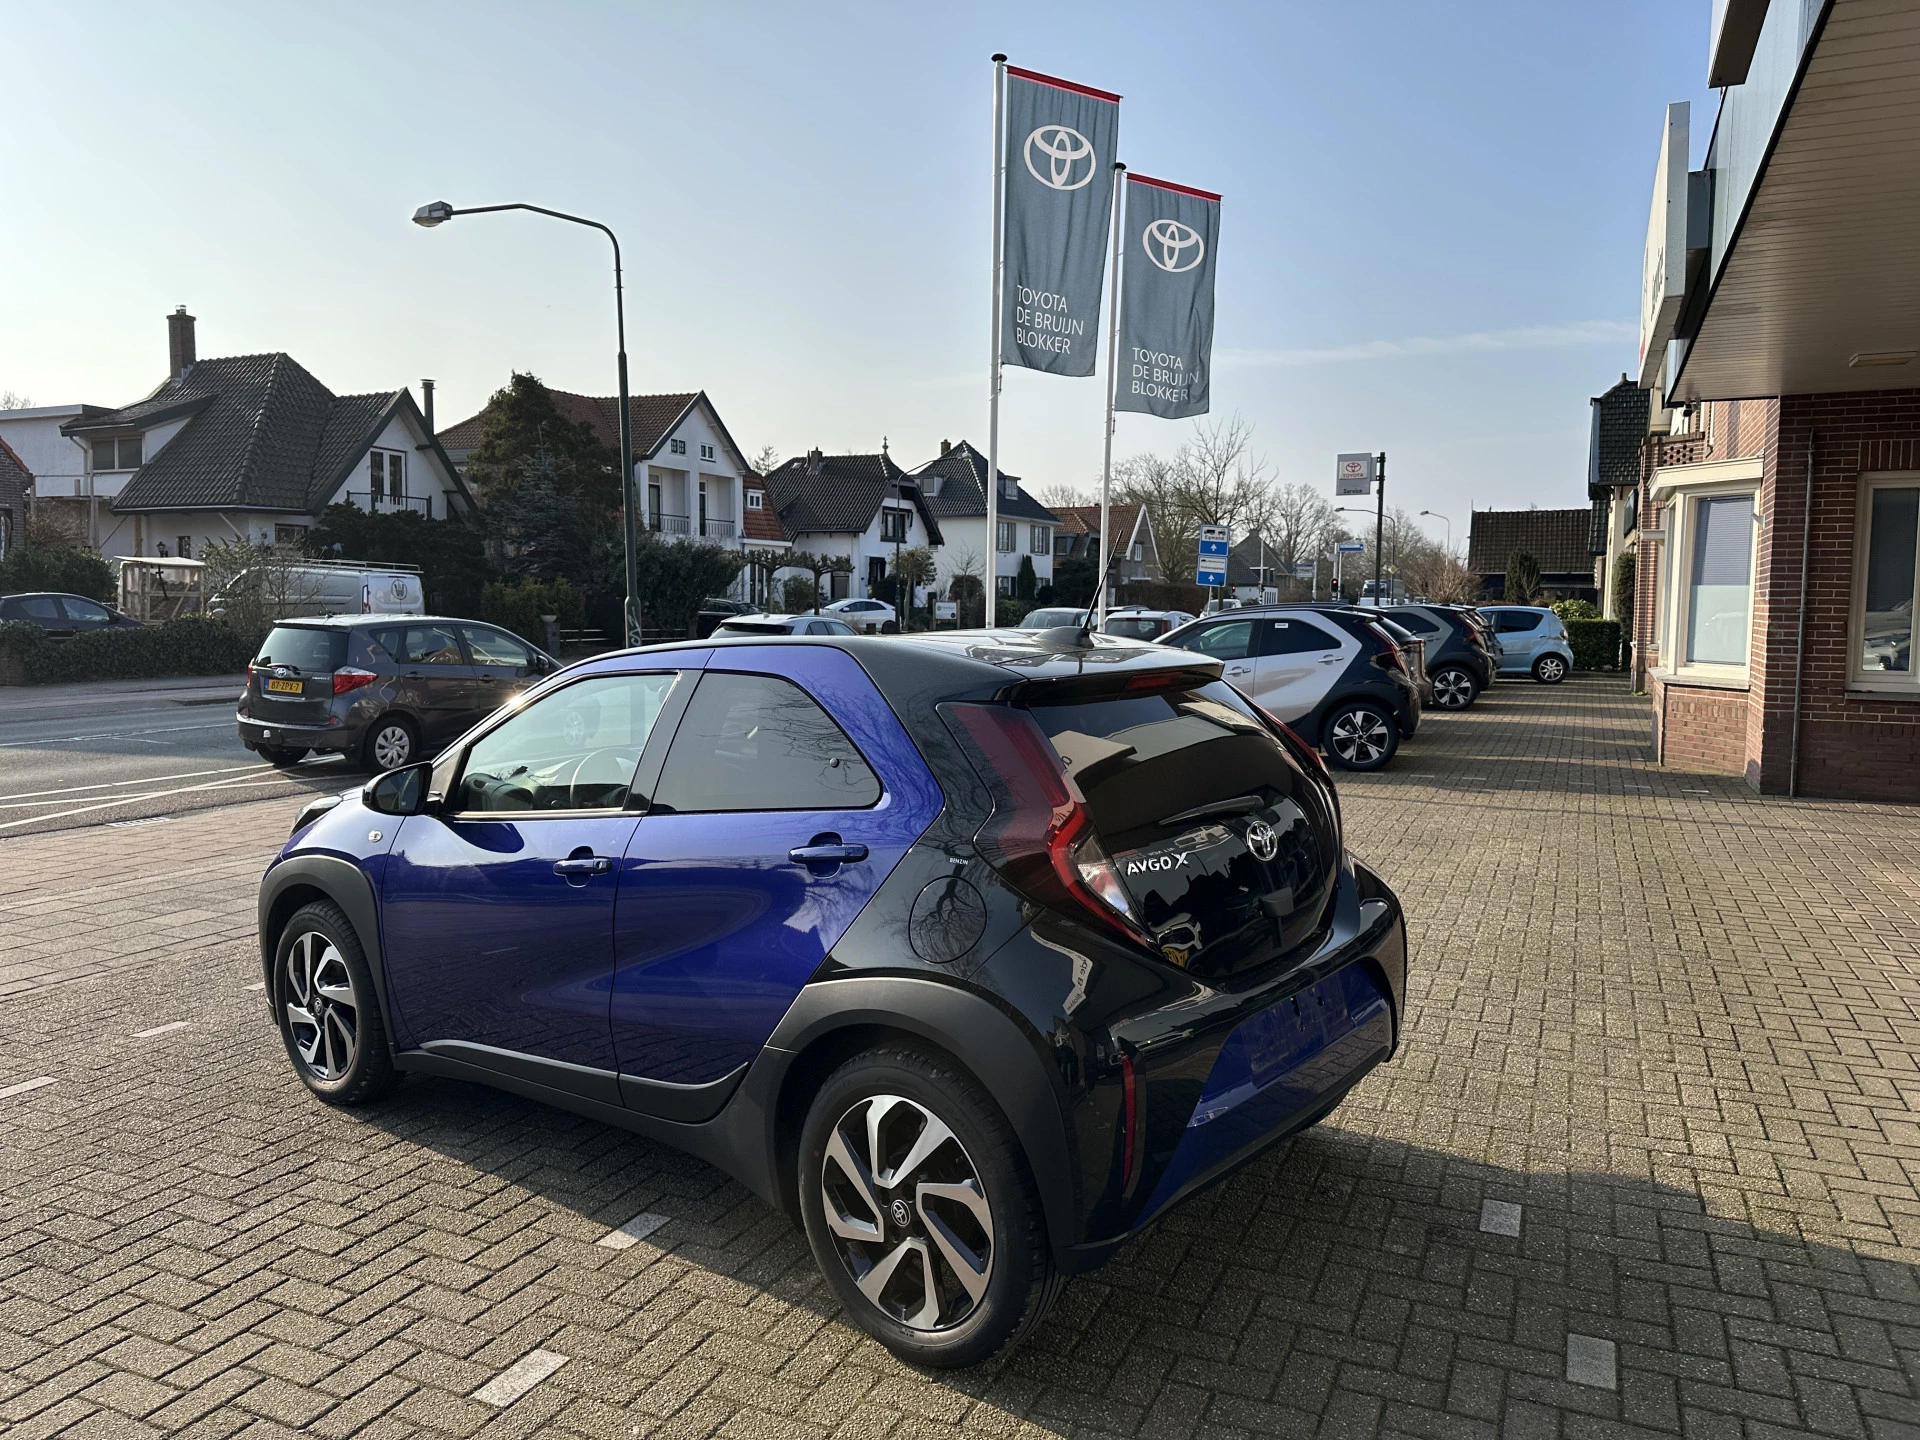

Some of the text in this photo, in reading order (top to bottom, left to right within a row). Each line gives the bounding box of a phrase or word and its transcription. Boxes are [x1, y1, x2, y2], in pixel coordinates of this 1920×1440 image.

[1017, 285, 1068, 313] TOYOTA
[1016, 306, 1084, 336] DE BRUIJN
[1016, 327, 1071, 354] BLOKKER
[1132, 347, 1183, 370] TOYOTA
[1132, 364, 1200, 387] DE BRUIJN
[1131, 380, 1189, 402] BLOKKER
[271, 681, 300, 692] 87-ZPX-7
[949, 857, 969, 865] BENZIN
[1171, 851, 1190, 871] X
